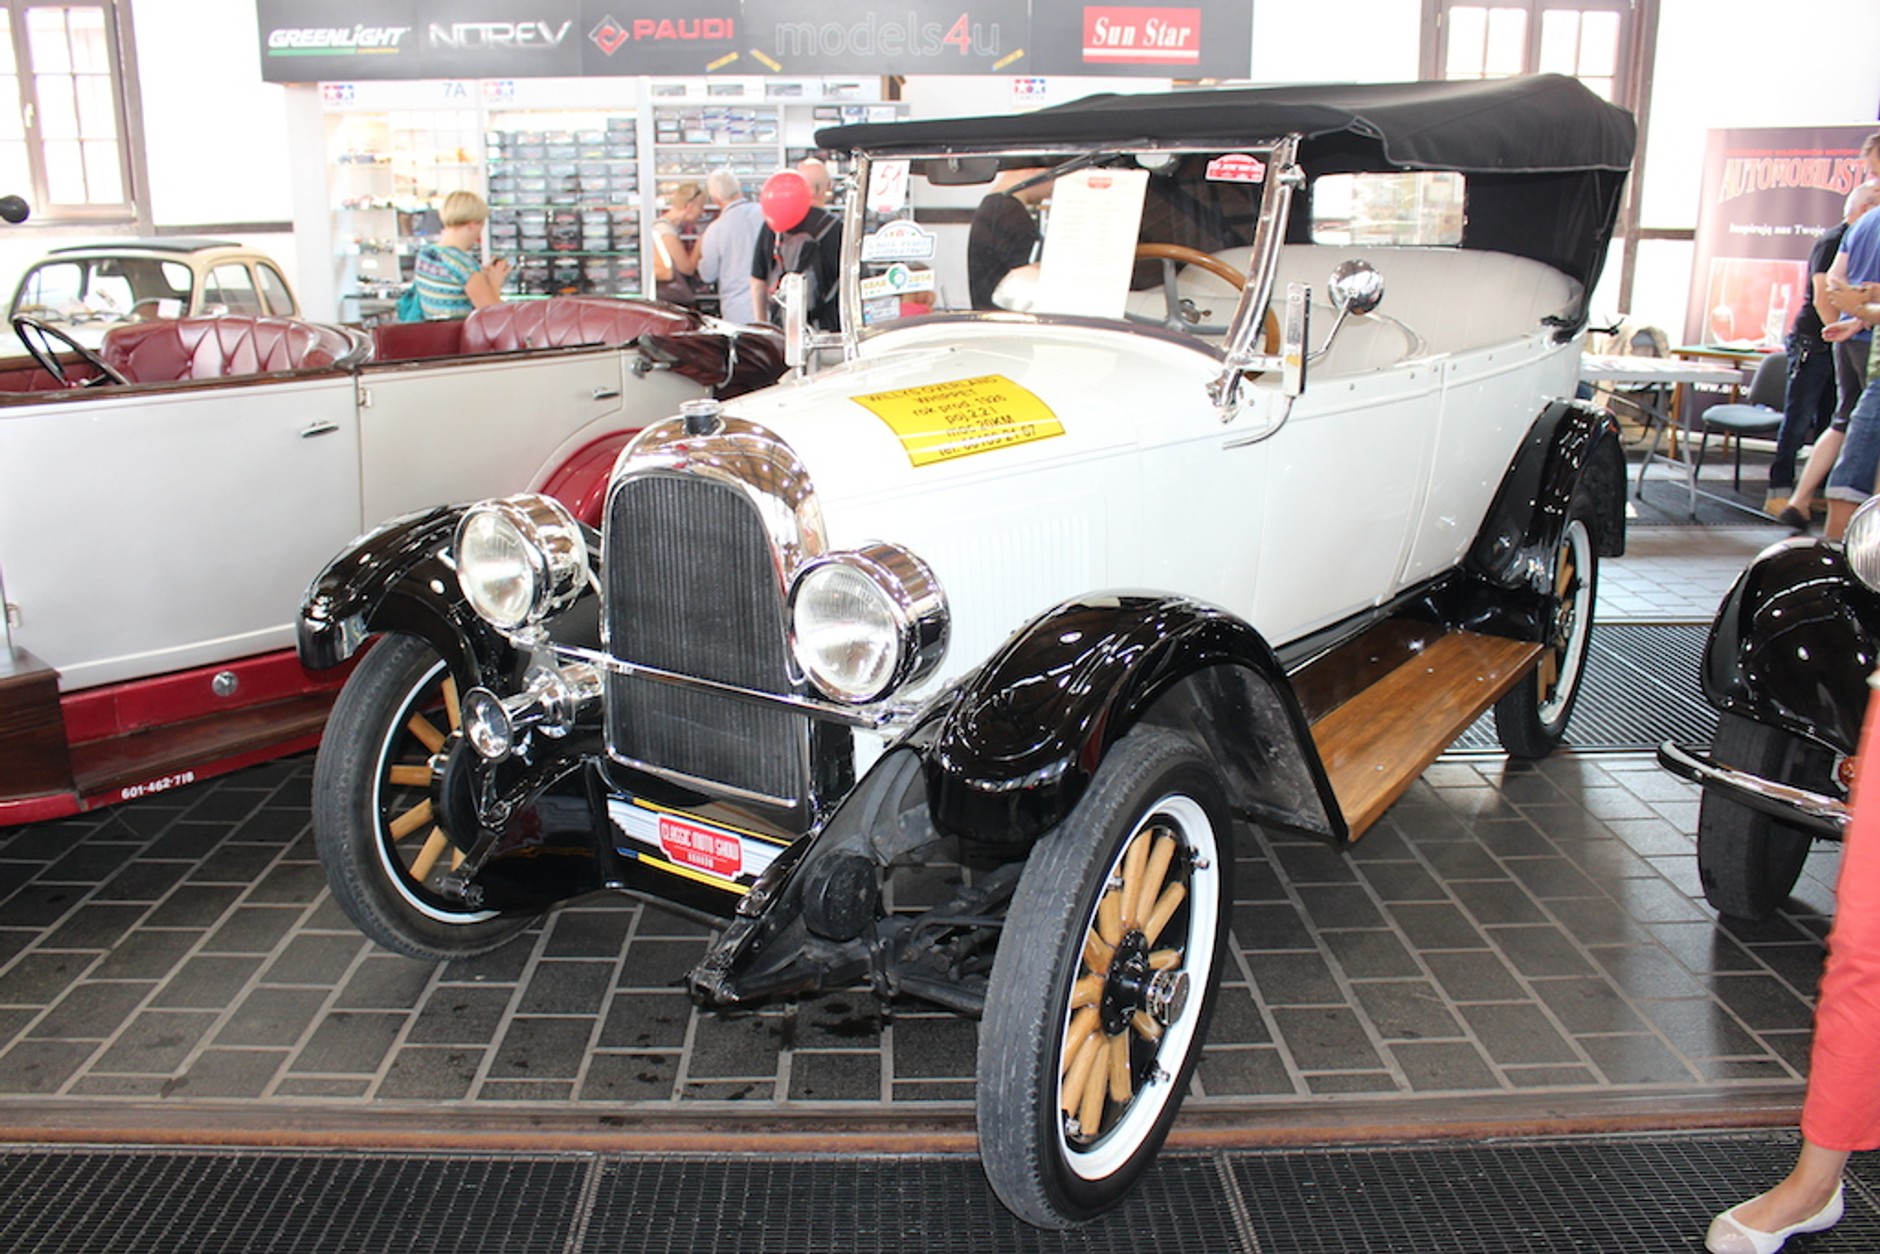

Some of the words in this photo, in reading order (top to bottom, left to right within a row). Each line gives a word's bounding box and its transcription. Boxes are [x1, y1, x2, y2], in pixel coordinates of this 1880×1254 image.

[428, 20, 572, 48] NOREV
[633, 18, 734, 41] PAUDI
[775, 11, 999, 56] models4u
[1092, 16, 1136, 46] Sun
[1142, 17, 1191, 47] Star
[443, 82, 467, 98] 7A
[1717, 156, 1876, 205] AUTOMOBILIST
[913, 406, 933, 416] rok
